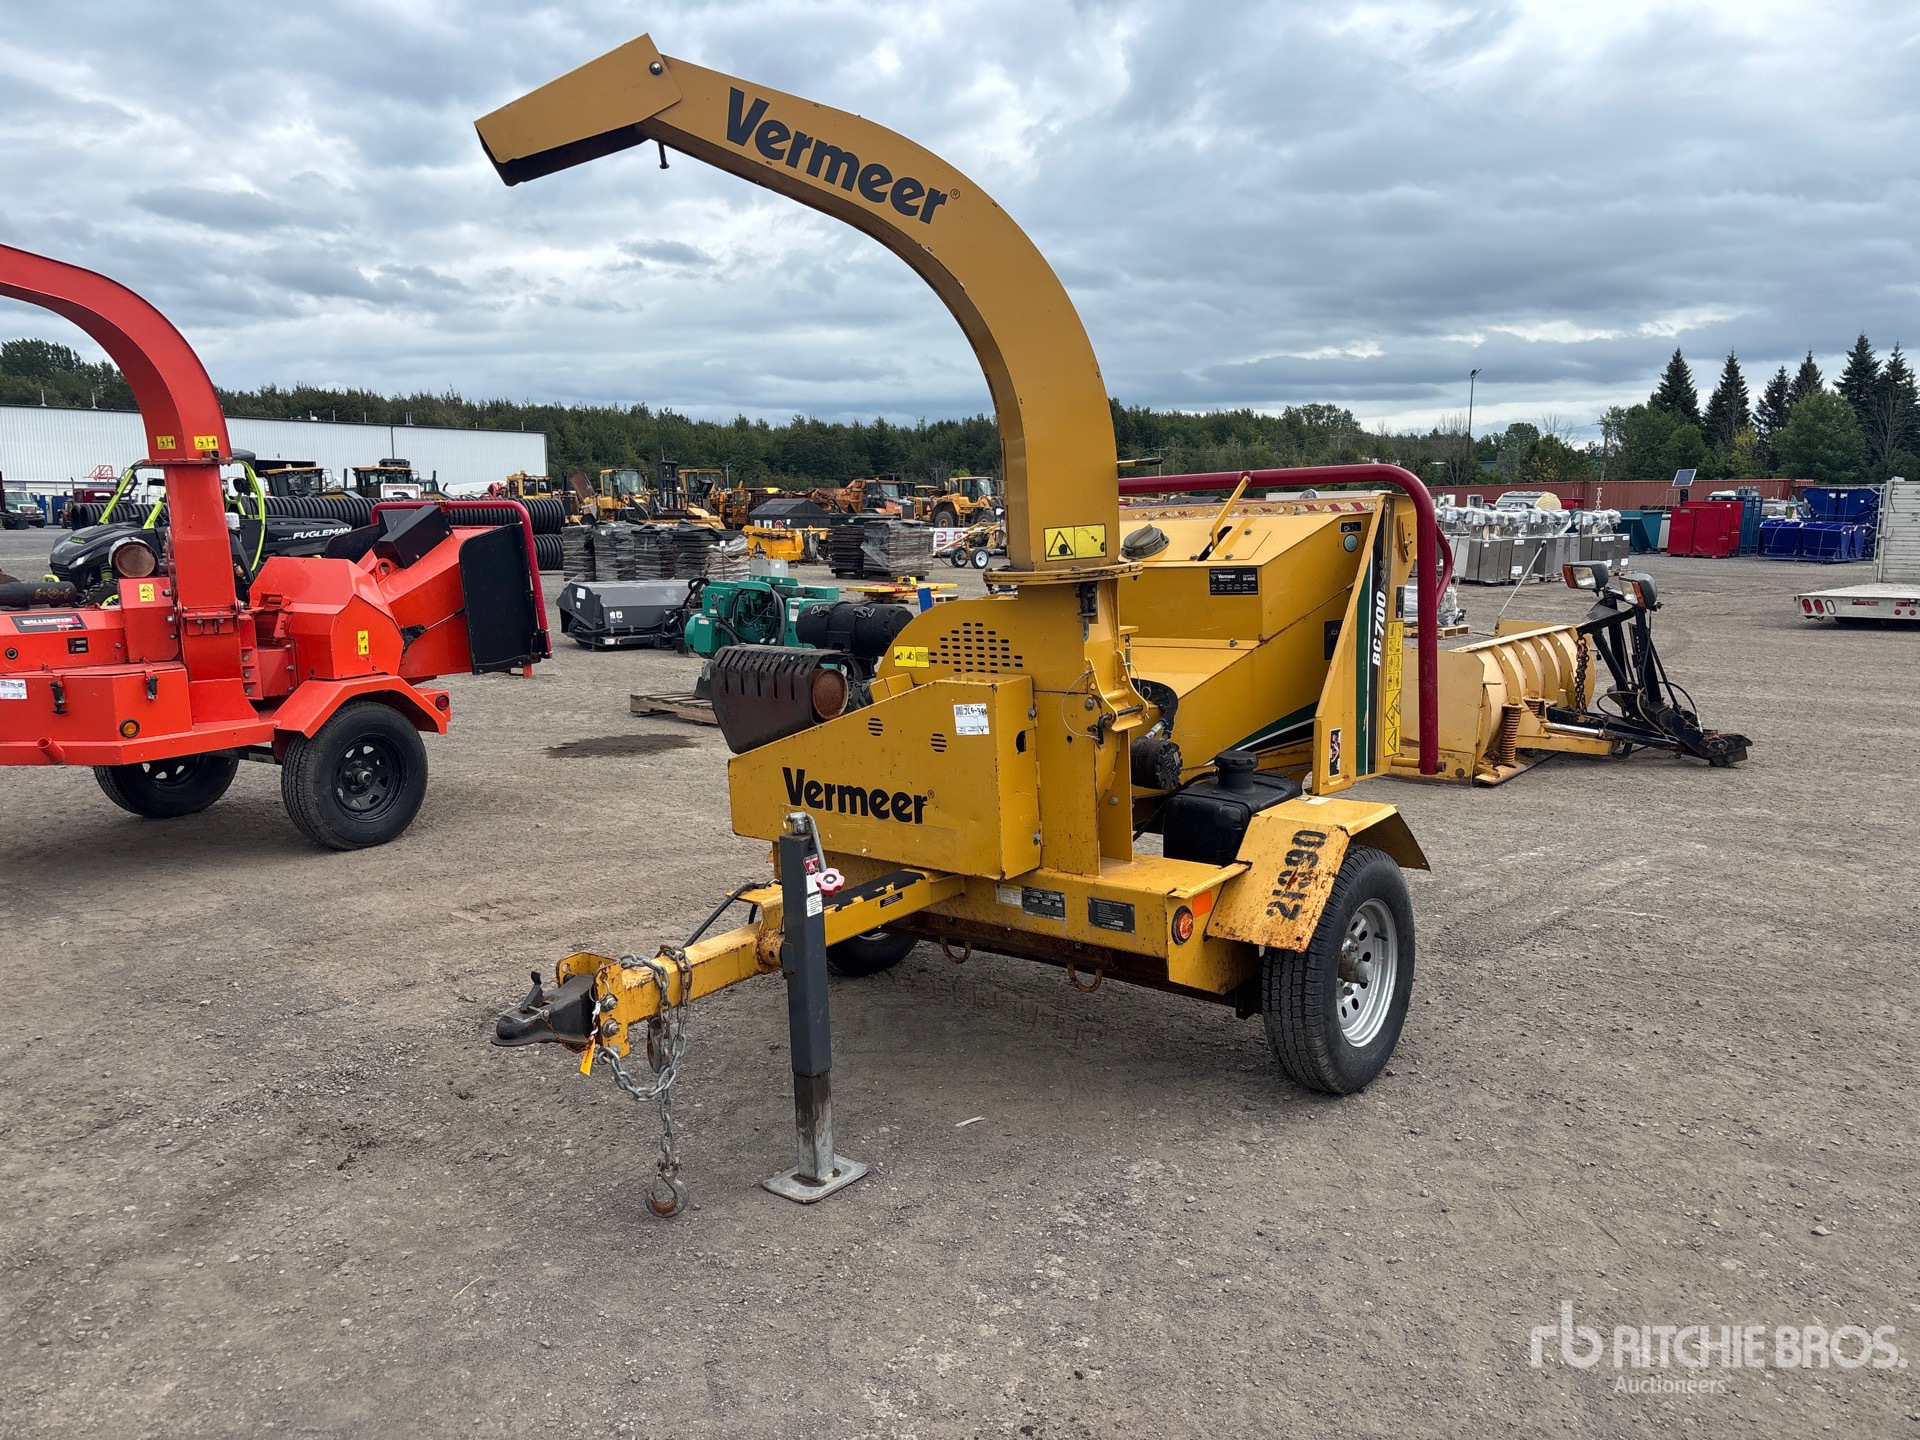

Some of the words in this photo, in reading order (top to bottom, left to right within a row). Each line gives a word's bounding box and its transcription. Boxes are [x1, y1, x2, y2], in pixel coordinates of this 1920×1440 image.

[726, 86, 949, 225] Vermeer
[292, 526, 353, 540] FUGLEMAN
[781, 766, 928, 825] Vermeer
